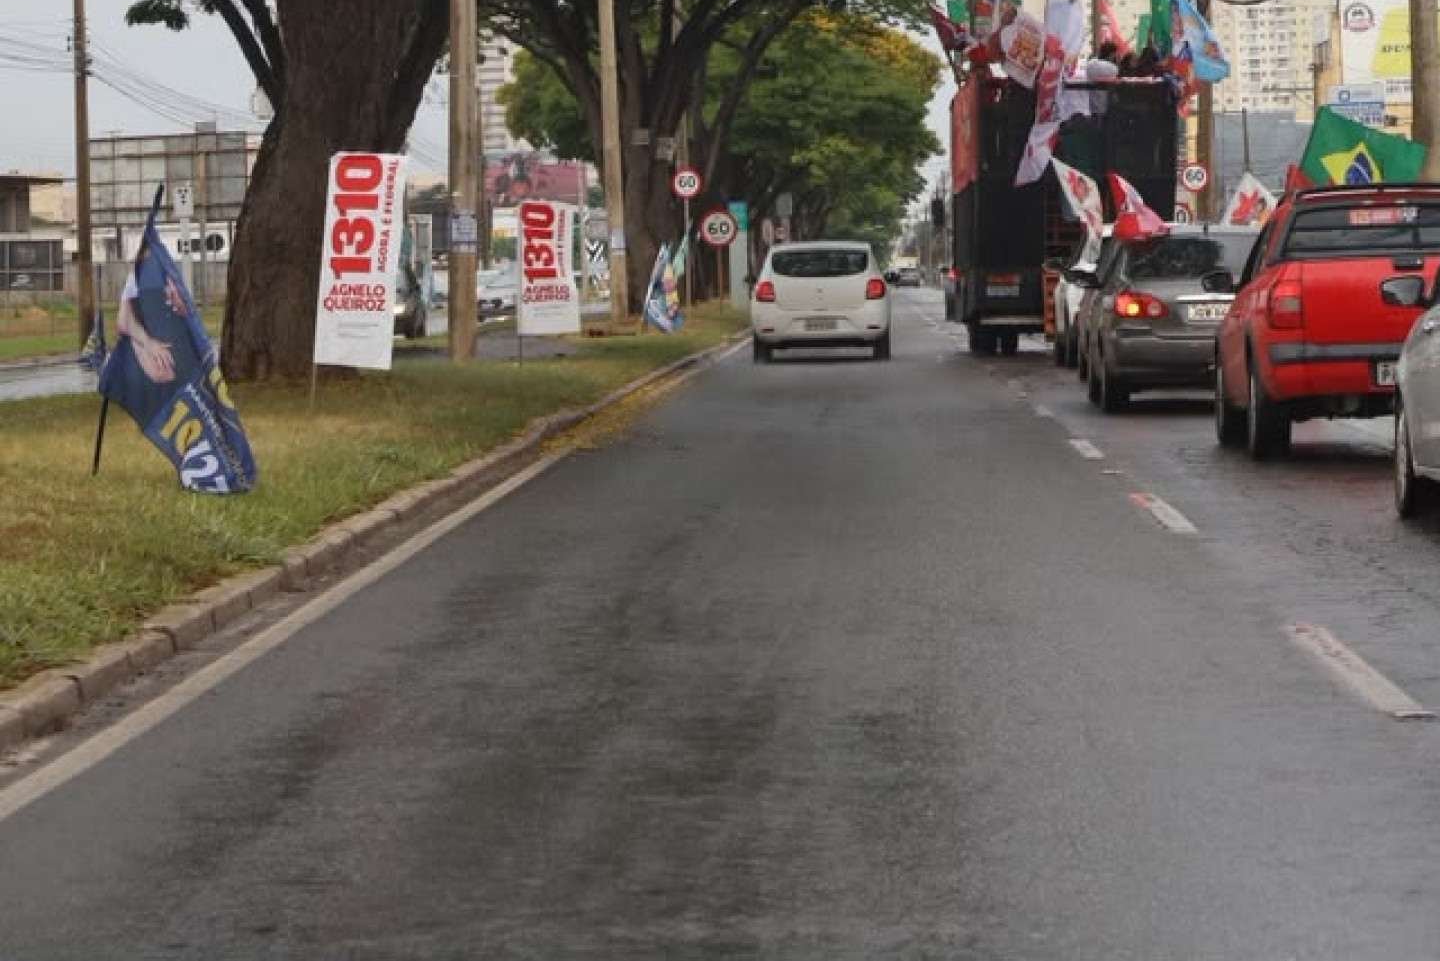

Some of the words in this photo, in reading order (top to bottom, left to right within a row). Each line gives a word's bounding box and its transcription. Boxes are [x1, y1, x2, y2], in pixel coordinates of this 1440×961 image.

[679, 175, 696, 188] 60
[331, 155, 383, 280] 1310
[708, 222, 730, 235] 60
[521, 202, 557, 285] 1310
[330, 284, 386, 298] AGNELO
[323, 298, 386, 312] QUEIROZ
